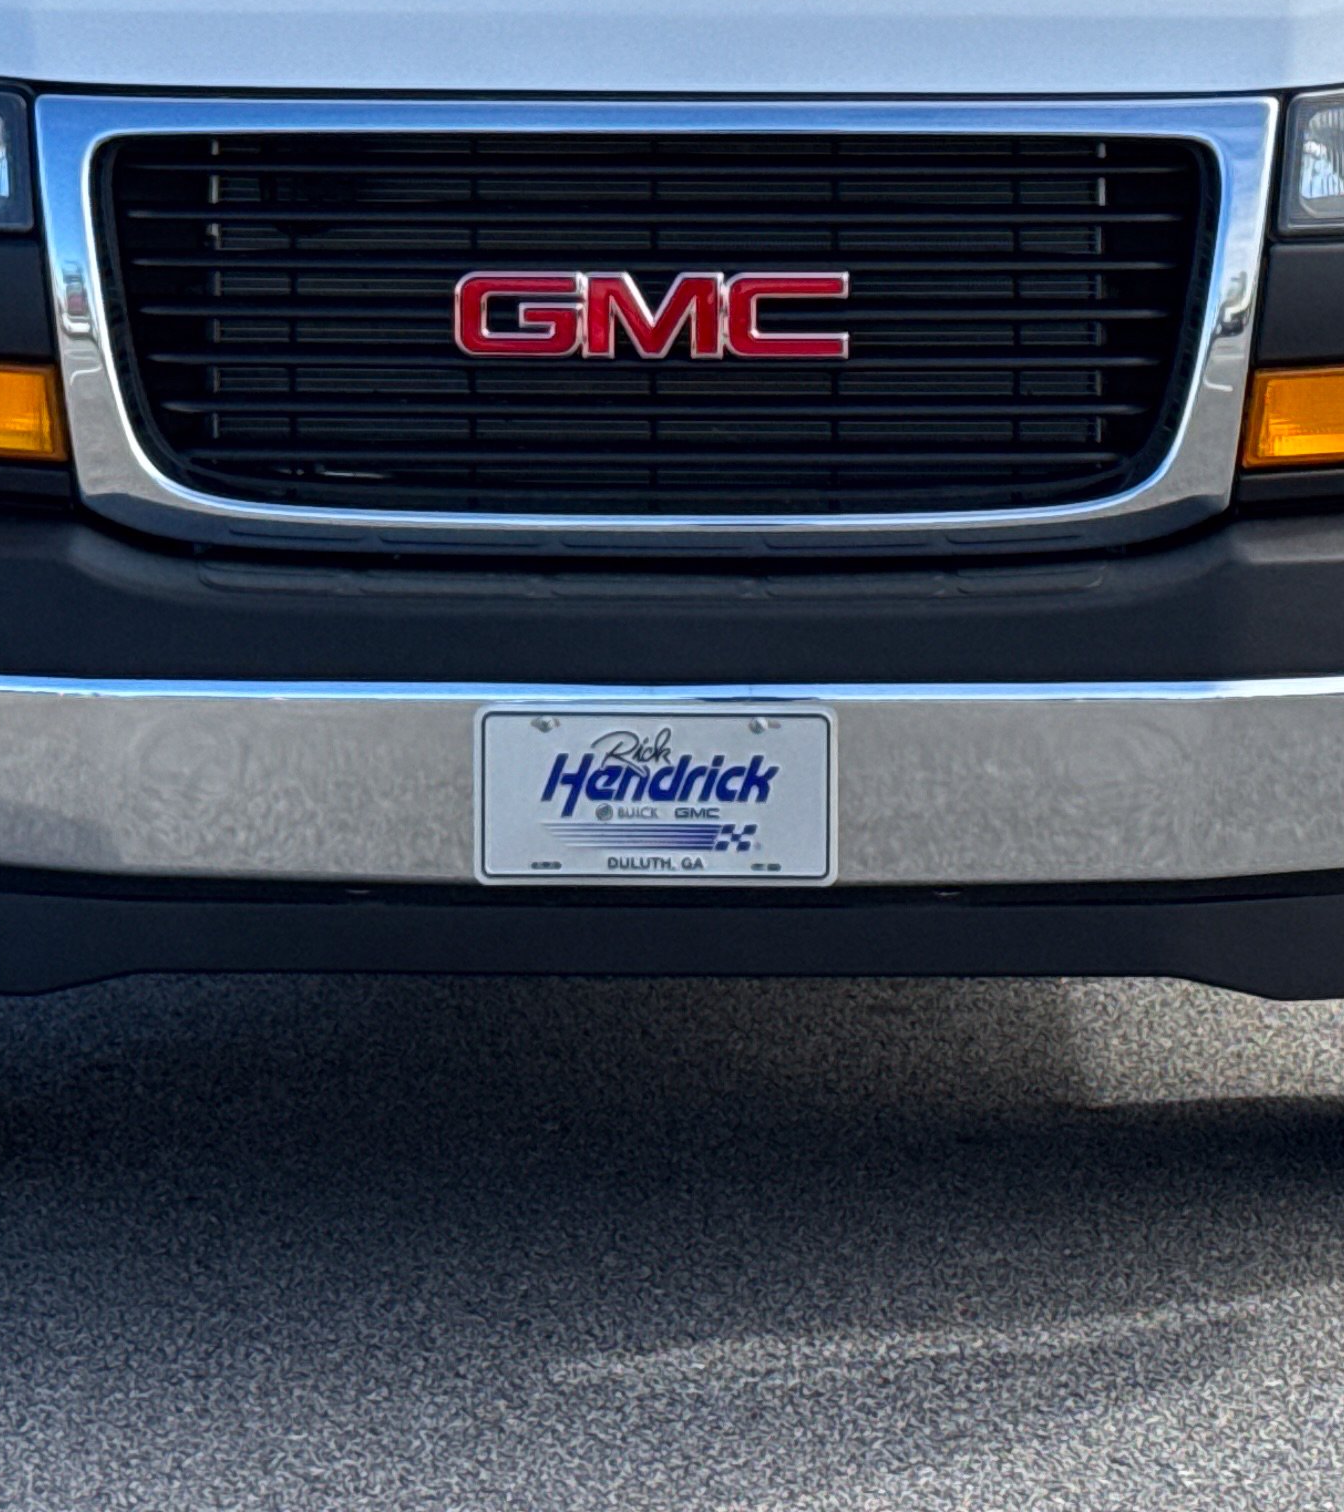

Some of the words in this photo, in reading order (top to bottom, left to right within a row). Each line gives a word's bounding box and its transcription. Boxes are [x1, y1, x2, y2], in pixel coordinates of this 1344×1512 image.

[455, 271, 849, 360] GMC
[591, 727, 672, 777] Rick
[541, 752, 780, 818] Hendrick
[617, 807, 659, 820] BUICK
[674, 807, 720, 819] GMC
[681, 856, 705, 871] GA
